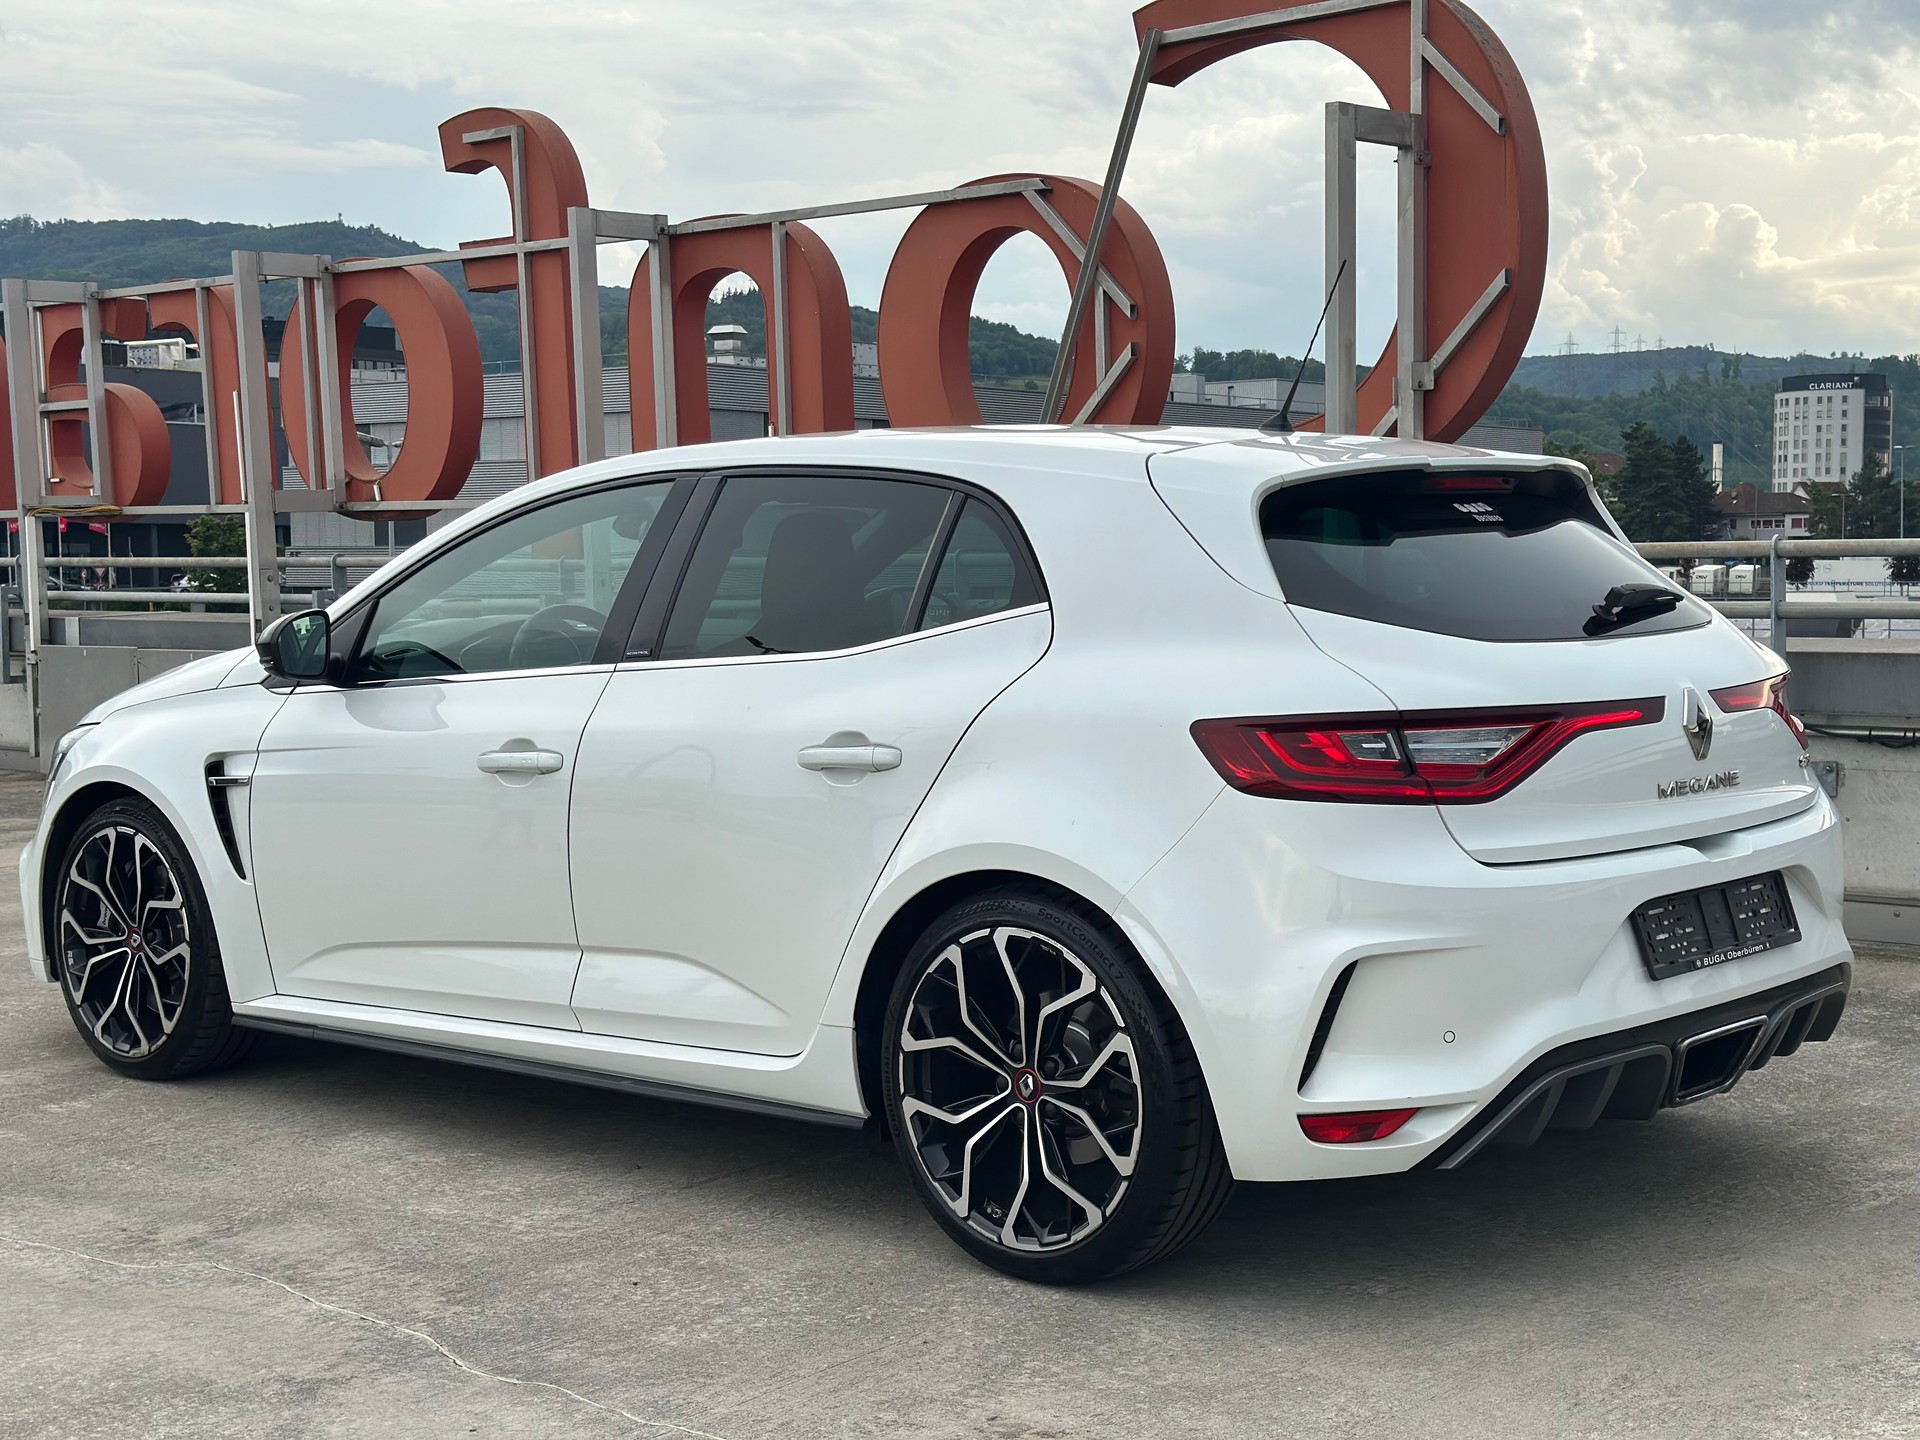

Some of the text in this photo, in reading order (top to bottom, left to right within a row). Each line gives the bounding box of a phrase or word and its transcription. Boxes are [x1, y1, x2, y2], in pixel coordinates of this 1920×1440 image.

[1809, 381, 1854, 390] CLARIANT
[1657, 769, 1741, 799] MEGANE
[1037, 907, 1115, 971] SportContact
[1703, 944, 1764, 966] BUGA Oberbüren
